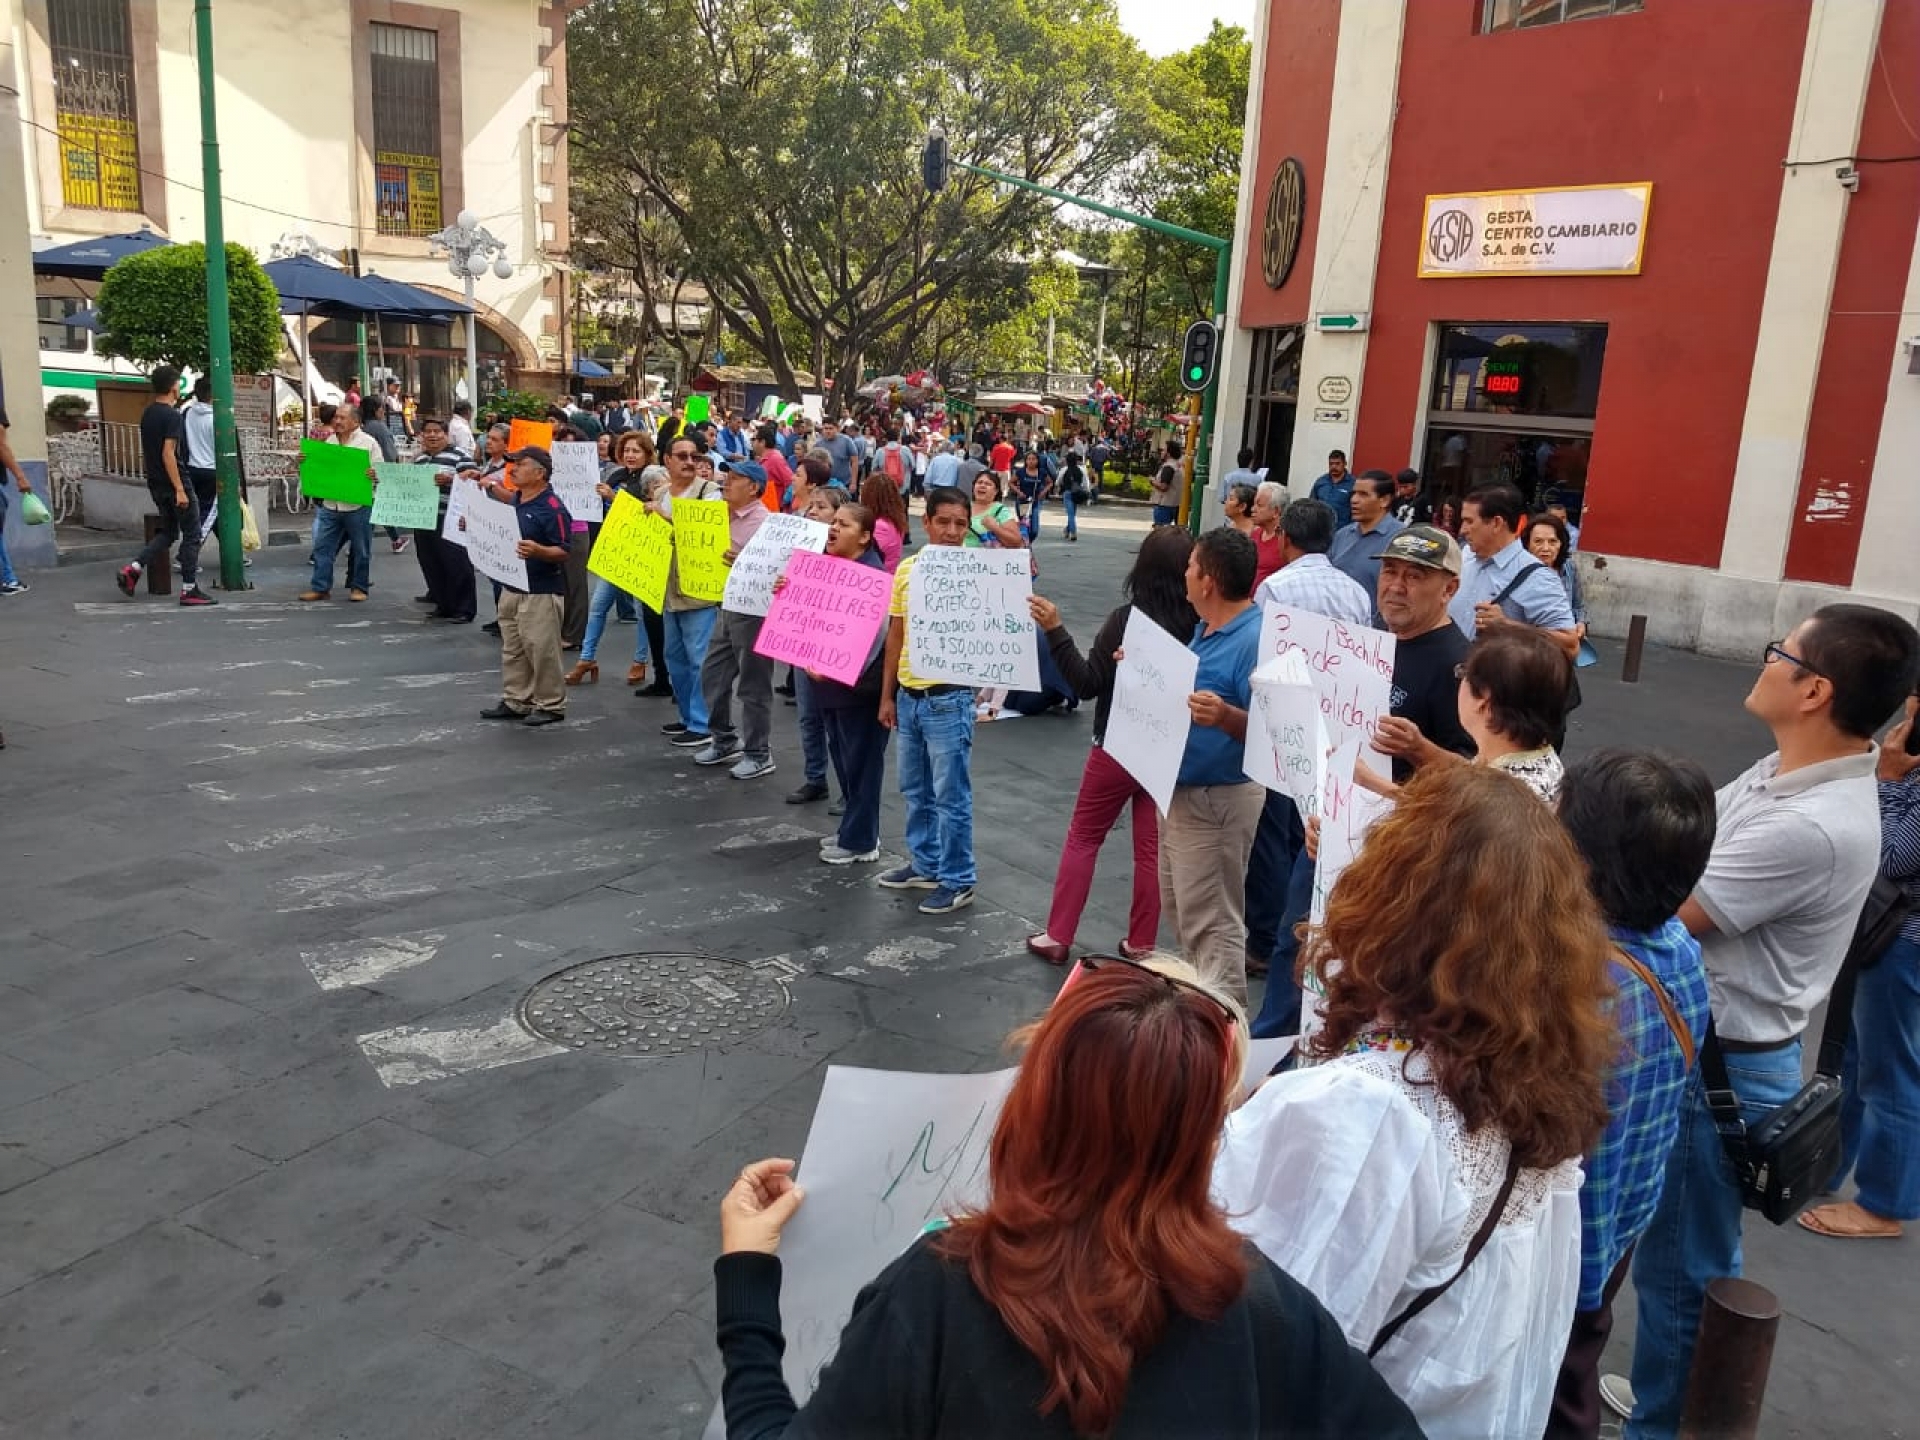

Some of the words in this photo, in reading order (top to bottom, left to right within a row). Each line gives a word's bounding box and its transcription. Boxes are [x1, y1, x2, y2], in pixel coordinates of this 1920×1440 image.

[1487, 209, 1533, 225] GESTA
[1484, 226, 1544, 241] CENTRO
[1547, 222, 1638, 239] CAMBIARIO
[1481, 245, 1507, 257] S.A.
[1511, 244, 1526, 256] de
[1529, 242, 1556, 256] C.V.
[793, 554, 885, 598] JUBILADOS
[924, 575, 981, 594] COBAEM
[777, 585, 882, 621] BACHILLERES
[779, 606, 846, 636] Exigimos
[983, 617, 1000, 632] UN
[916, 636, 931, 649] DE
